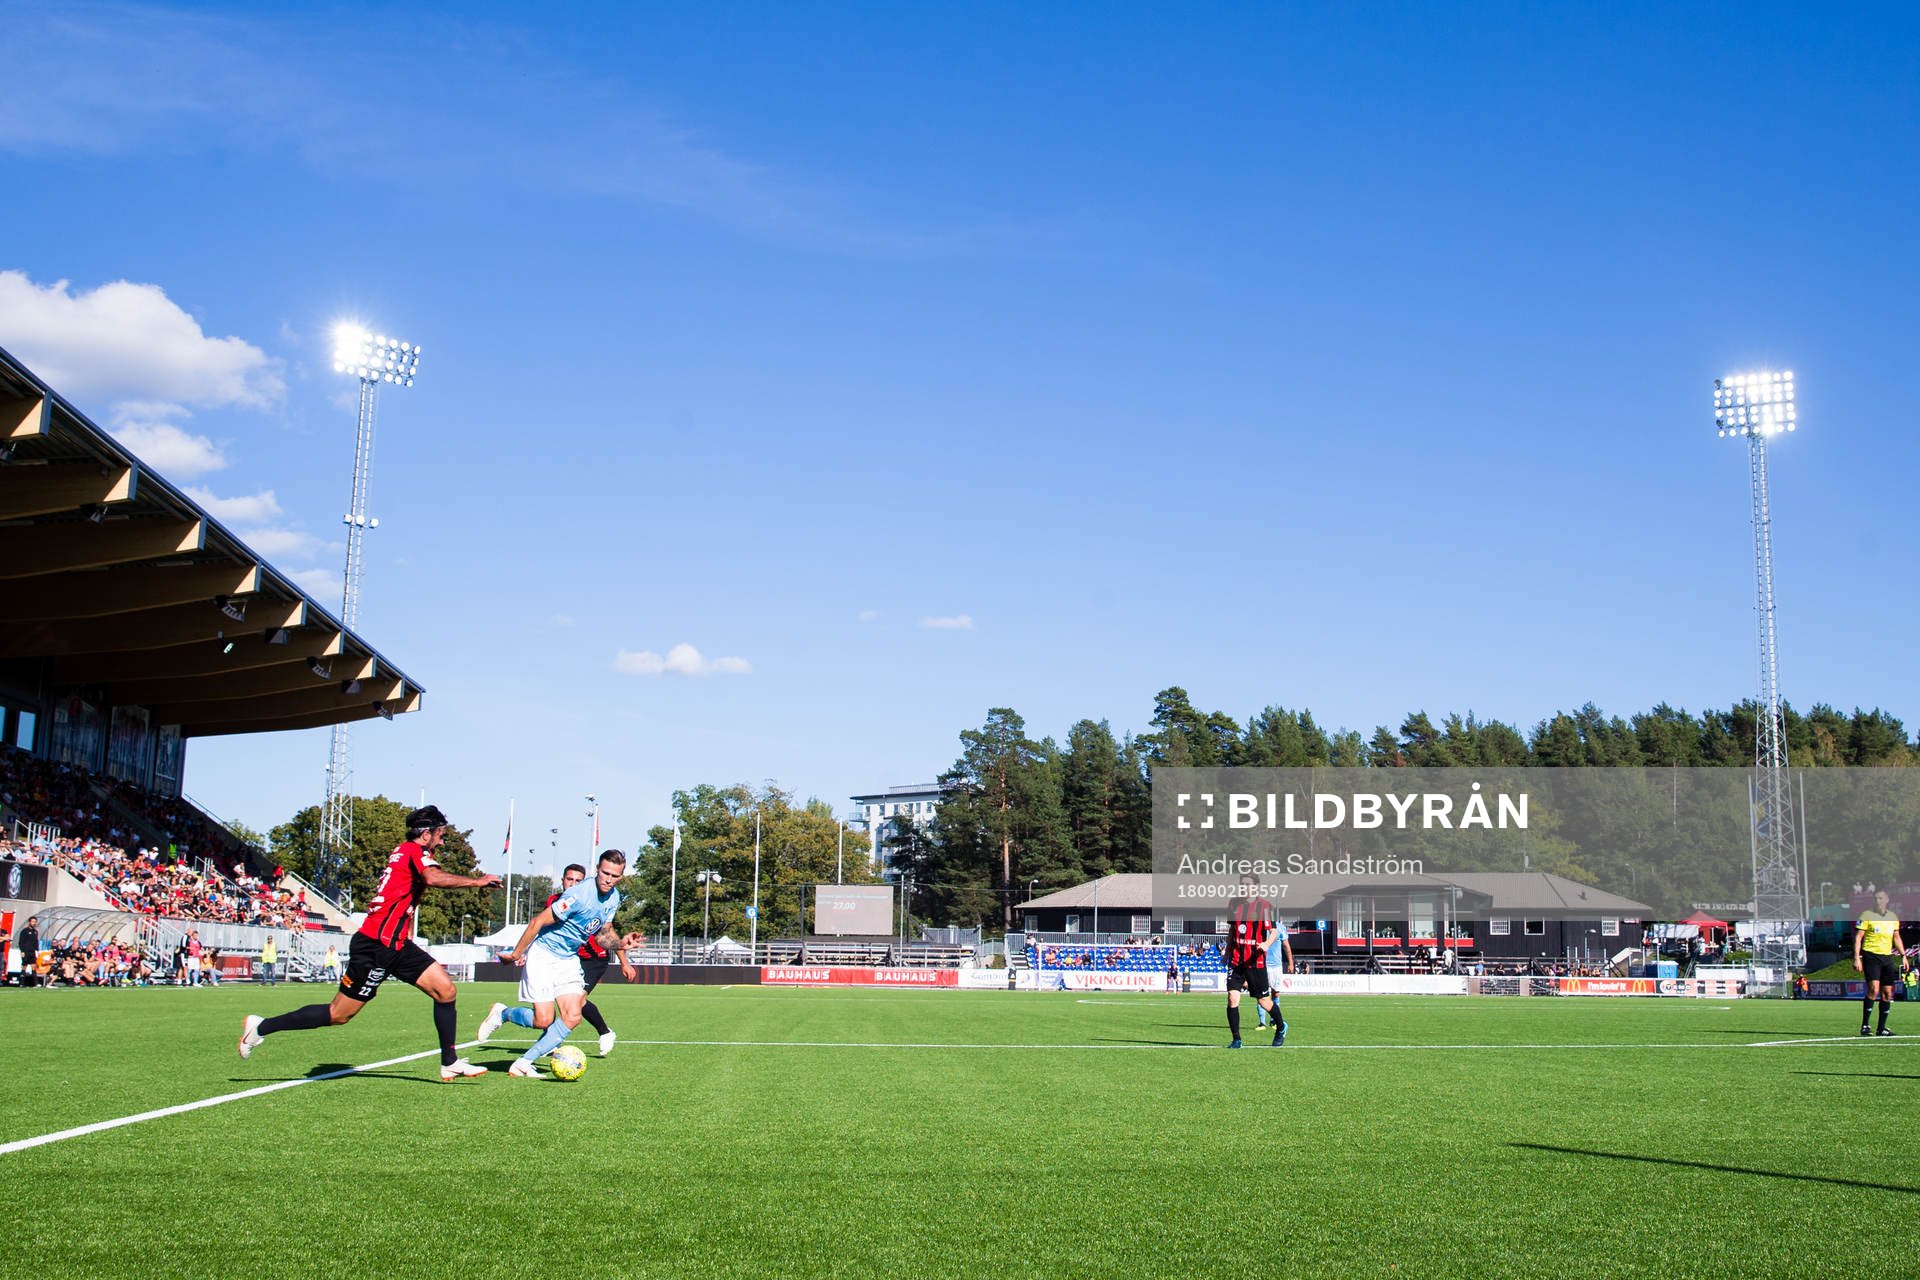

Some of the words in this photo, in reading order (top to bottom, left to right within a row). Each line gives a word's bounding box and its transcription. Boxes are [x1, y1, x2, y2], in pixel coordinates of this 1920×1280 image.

[768, 969, 830, 980] BAUHAUS
[876, 971, 937, 982] BAUHAUS
[1075, 974, 1123, 987] VIKING
[1126, 974, 1157, 986] LINE
[358, 986, 372, 997] 22
